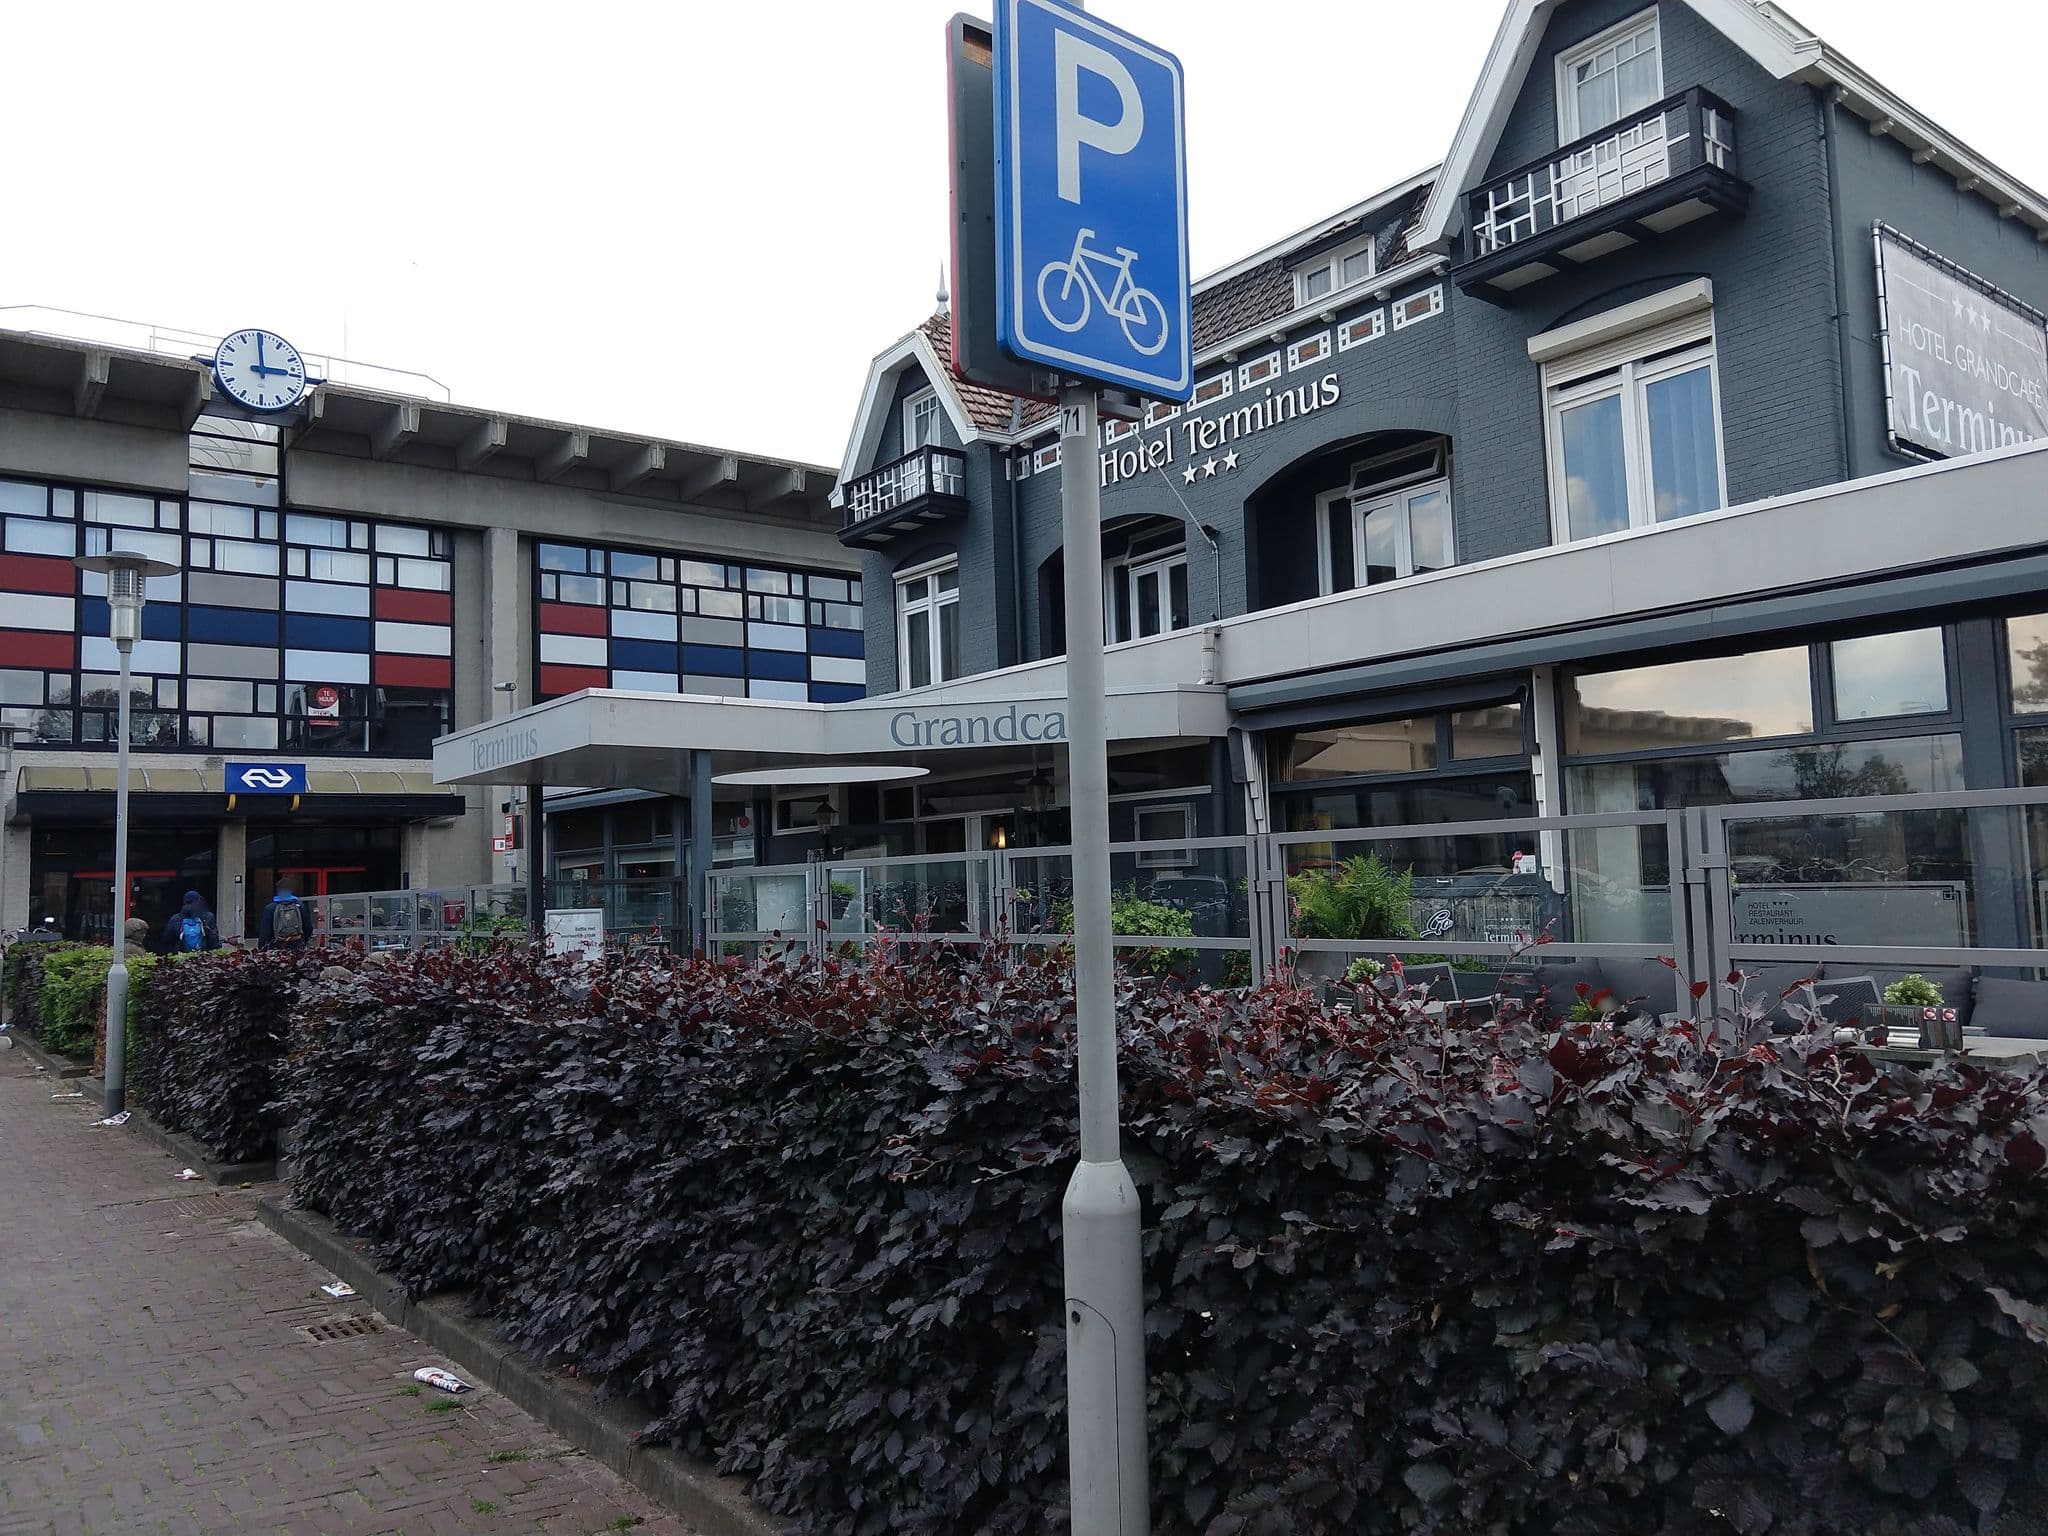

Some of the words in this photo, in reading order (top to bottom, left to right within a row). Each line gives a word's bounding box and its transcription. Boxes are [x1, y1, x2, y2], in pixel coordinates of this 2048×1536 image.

[1055, 27, 1145, 206] P
[1899, 314, 1952, 366] HOTEL
[1954, 343, 2042, 409] GRANDCAFÉ
[1062, 406, 1082, 434] 71
[1100, 426, 1174, 488] Hotel
[1181, 372, 1342, 457] Terminus
[470, 727, 538, 771] Terminus
[1747, 902, 1770, 910] HOTEL
[1748, 909, 1793, 917] RESTAURANT
[1748, 917, 1805, 926] ZALENVERHUUR
[1483, 931, 1533, 943] Termins
[1734, 928, 1838, 946] rminus
